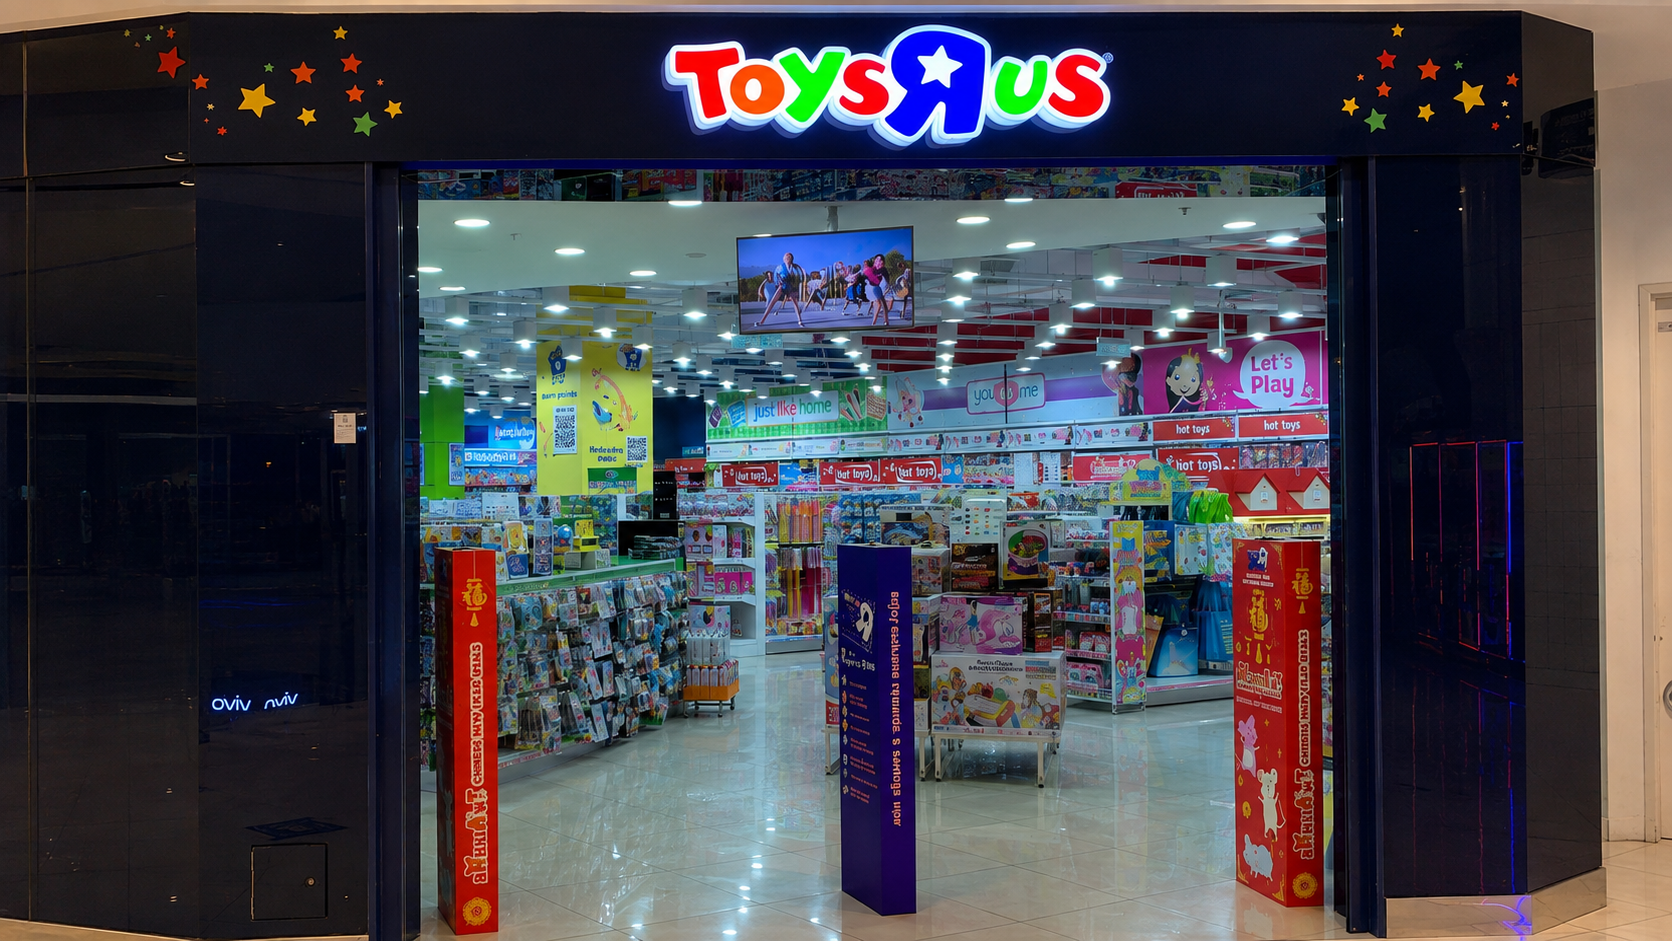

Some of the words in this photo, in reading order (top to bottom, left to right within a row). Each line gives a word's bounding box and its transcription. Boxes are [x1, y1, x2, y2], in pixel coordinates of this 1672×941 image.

[1251, 352, 1293, 371] Let's
[1020, 385, 1038, 398] me
[1251, 374, 1294, 398] Play
[753, 401, 775, 422] just
[799, 398, 832, 415] home
[1175, 424, 1190, 434] hot
[1192, 425, 1210, 436] toys
[1264, 420, 1278, 431] hot
[1281, 420, 1301, 432] toys
